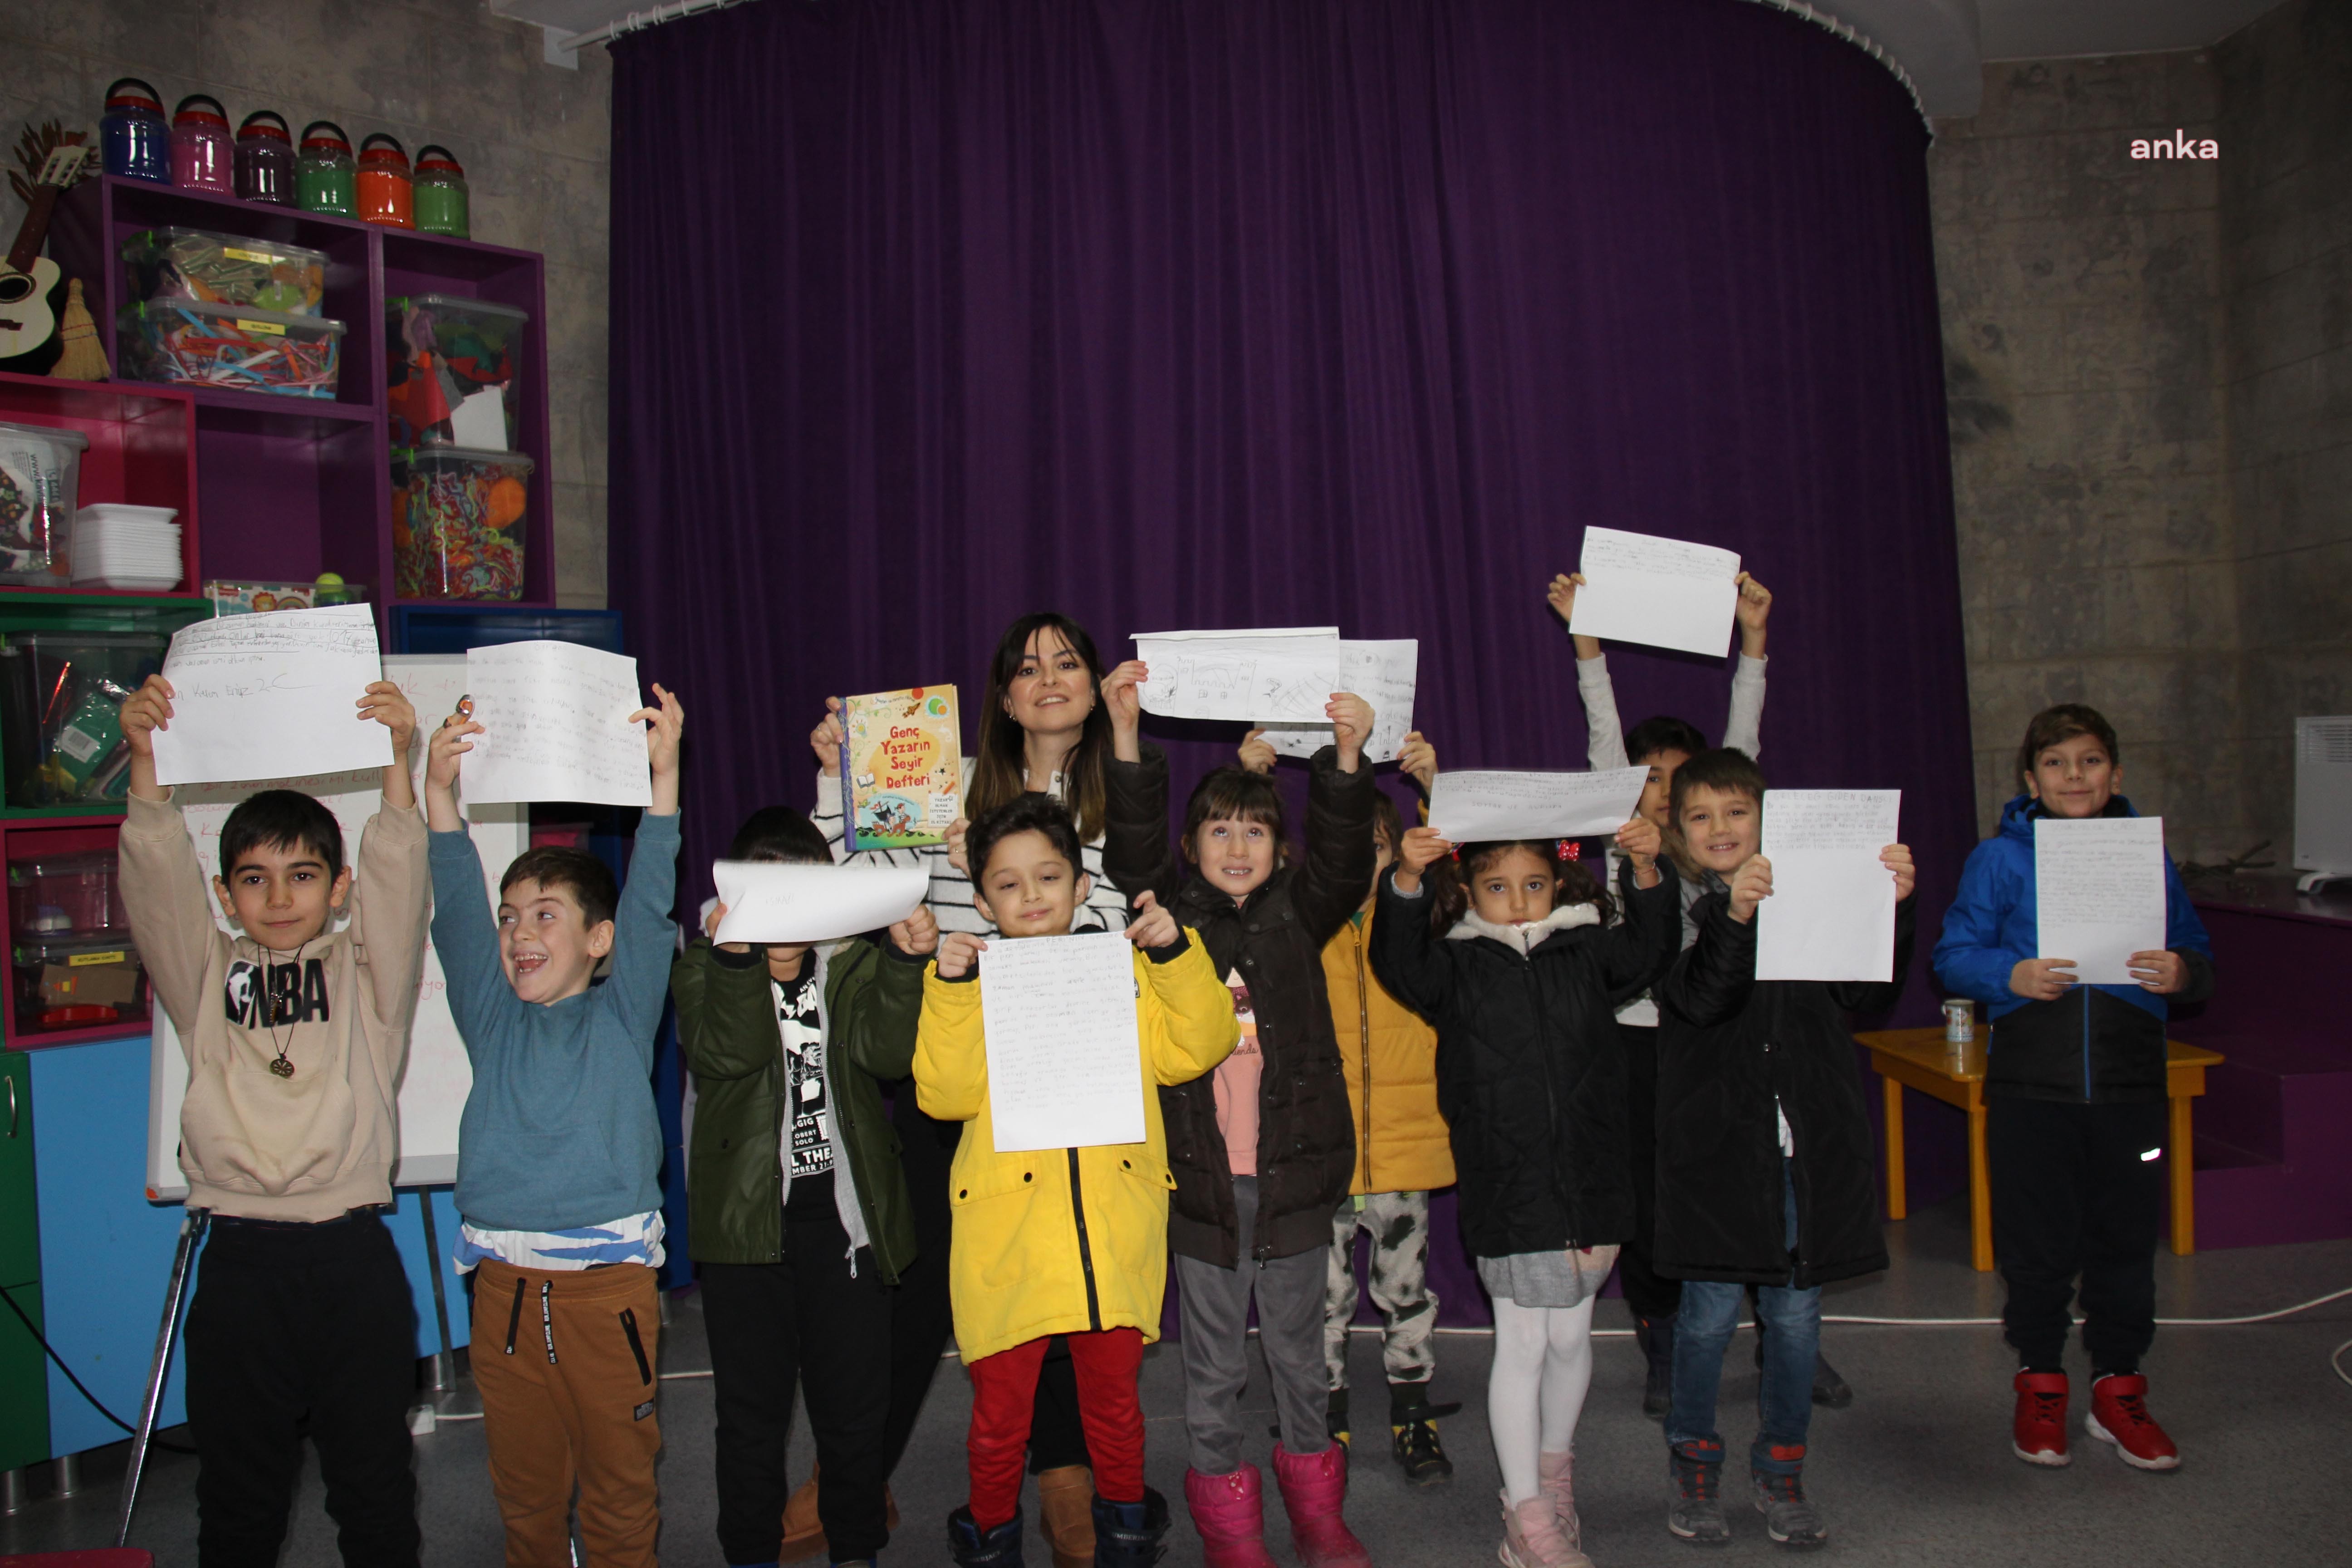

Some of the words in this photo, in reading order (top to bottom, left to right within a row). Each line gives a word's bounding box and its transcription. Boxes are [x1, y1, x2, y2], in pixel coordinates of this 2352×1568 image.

[890, 726, 920, 740] Genç
[880, 740, 930, 755] Yazarın
[891, 755, 923, 772] Seyir
[886, 773, 930, 789] Defteri
[248, 958, 330, 1030] NBA
[797, 1117, 814, 1128] GIG
[794, 1129, 817, 1139] OBERT
[795, 1137, 813, 1147] SOLO
